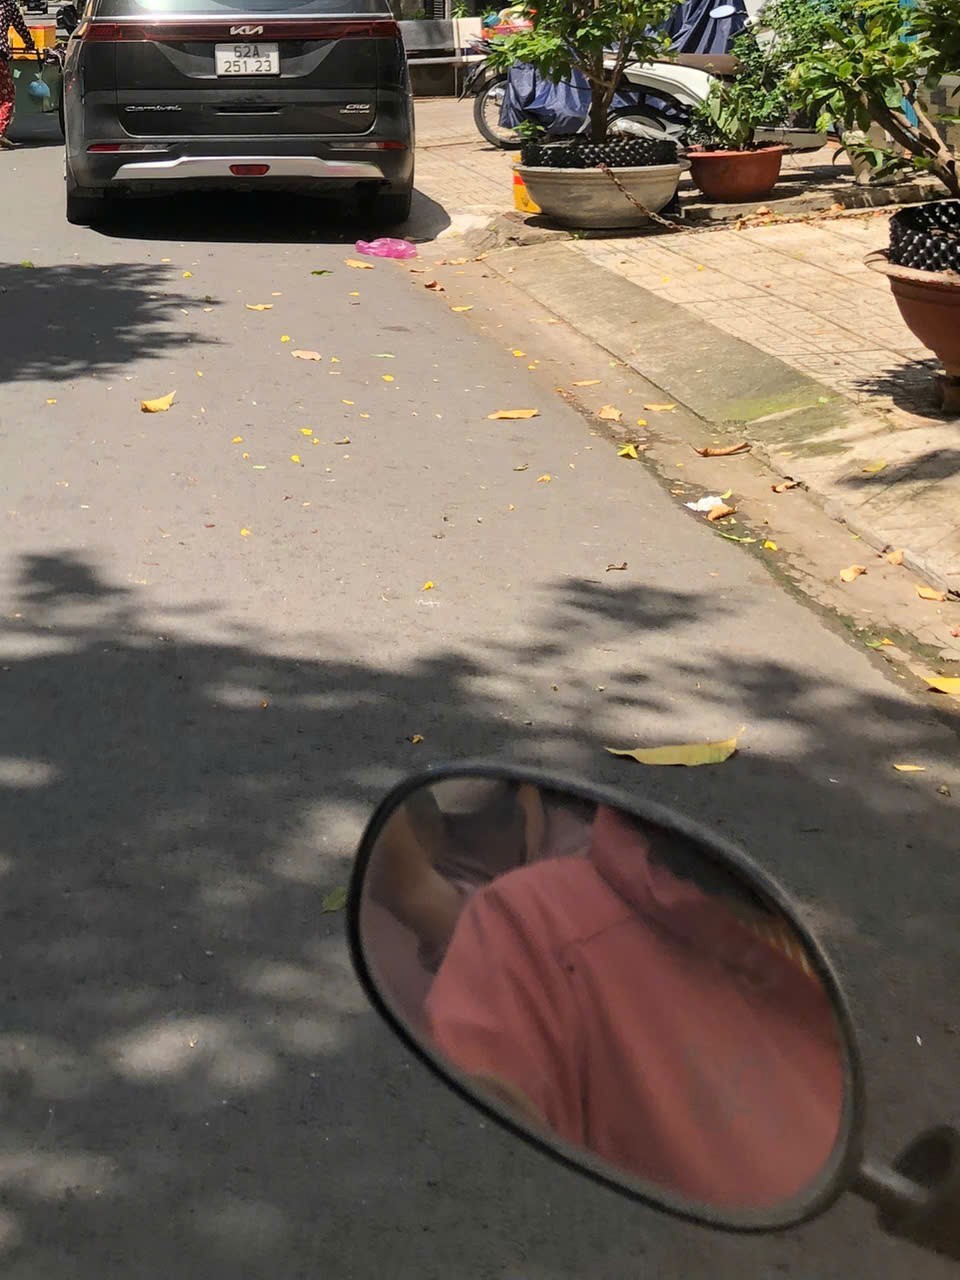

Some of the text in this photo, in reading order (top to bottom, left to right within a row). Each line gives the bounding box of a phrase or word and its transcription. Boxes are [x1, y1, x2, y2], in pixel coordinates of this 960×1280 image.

[230, 25, 264, 35] KIA
[234, 45, 260, 58] 62A
[224, 60, 272, 73] 251.23
